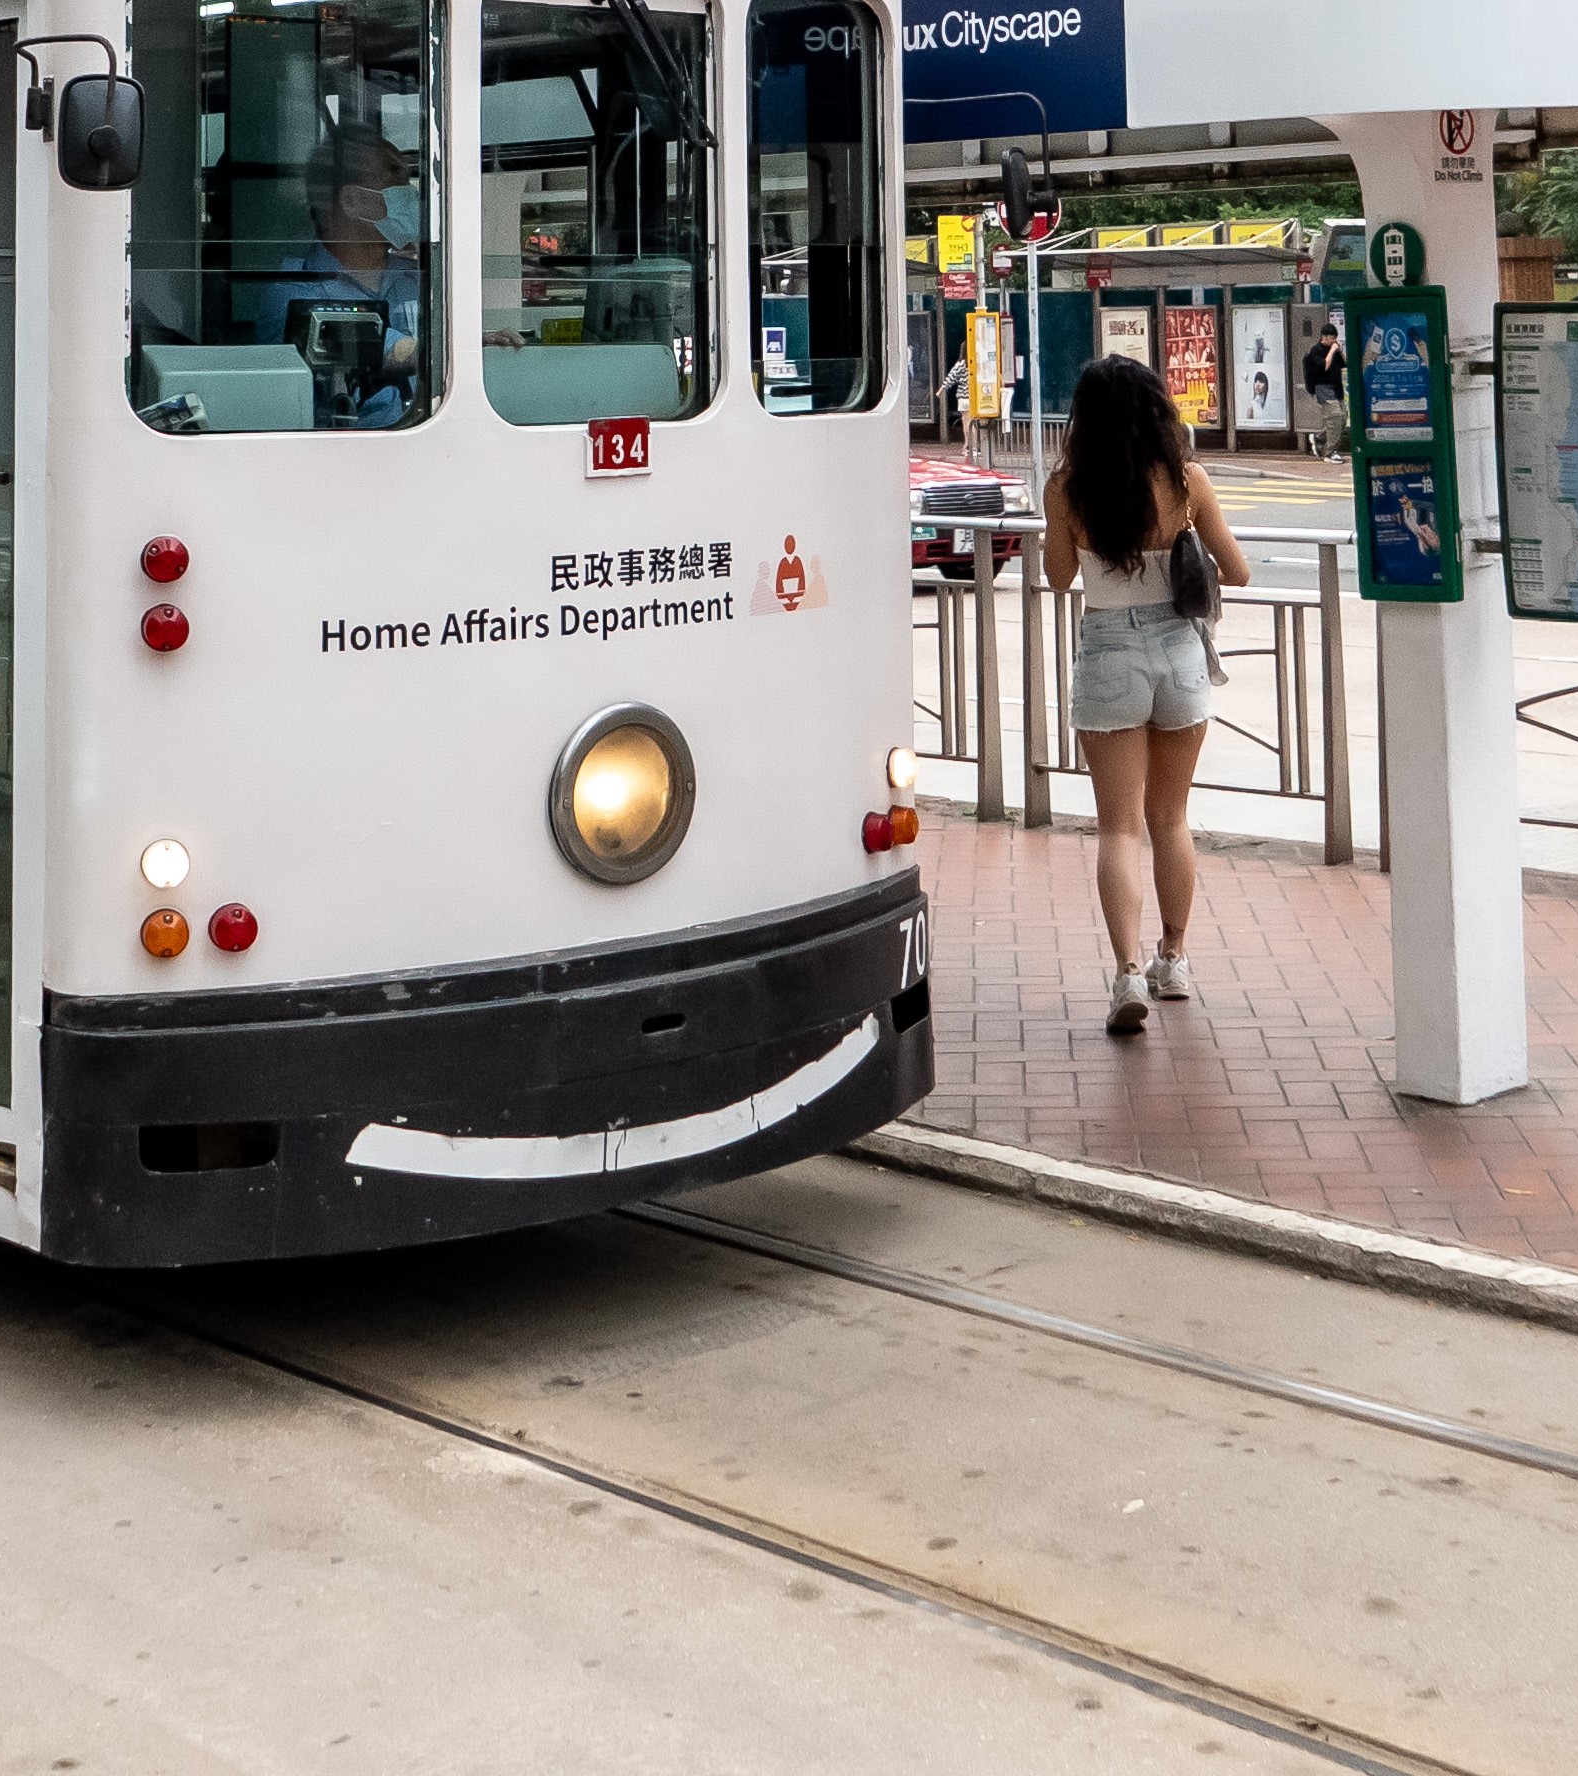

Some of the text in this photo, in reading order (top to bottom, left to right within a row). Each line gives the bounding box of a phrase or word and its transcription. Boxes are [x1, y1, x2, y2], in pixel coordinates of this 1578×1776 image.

[940, 5, 1081, 55] Cityscape
[1447, 170, 1460, 181] Not
[594, 432, 644, 466] 134
[550, 541, 733, 593] 民政事務總署
[321, 590, 735, 653] Home Affairs Department
[899, 910, 926, 989] 70
